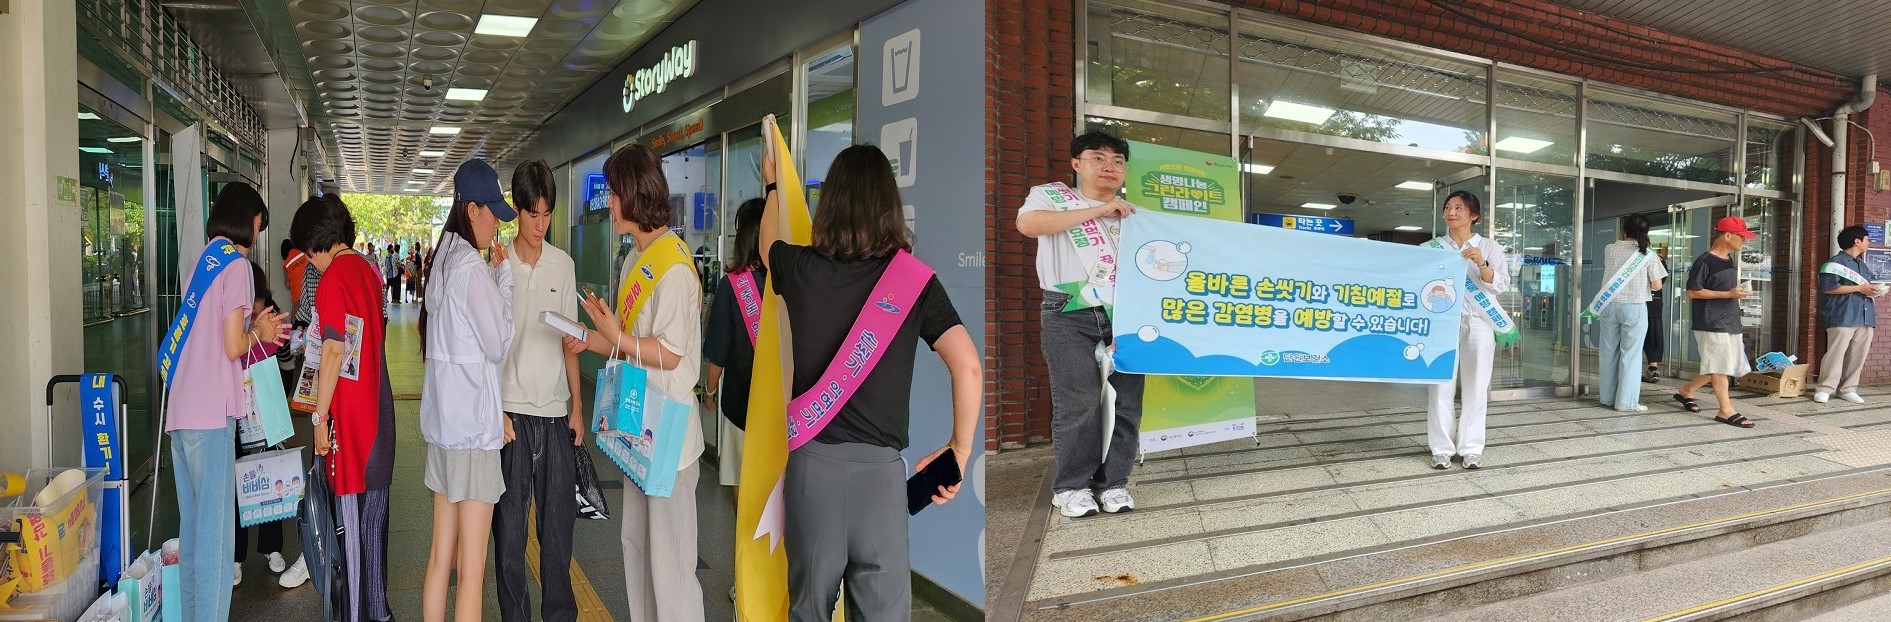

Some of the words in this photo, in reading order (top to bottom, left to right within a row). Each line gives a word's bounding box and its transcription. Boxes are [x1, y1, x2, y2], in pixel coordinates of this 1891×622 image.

[1159, 174, 1207, 189] 생명나눔
[1163, 197, 1208, 213] 캠페인
[1298, 217, 1314, 226] 타는
[1315, 218, 1323, 227] 곳
[1185, 270, 1250, 297] 올바른
[1255, 277, 1328, 302] 손씻기와
[1333, 284, 1417, 308] 기침예절로
[1161, 297, 1207, 323] 많은
[1213, 302, 1289, 327] 감염병을
[1294, 307, 1349, 330] 예방할
[1351, 314, 1367, 330] 수
[1369, 315, 1430, 336] 있습니다!
[844, 329, 878, 379] 손씻기
[1283, 352, 1330, 363] 단원보건소
[93, 396, 106, 426] 수시
[800, 380, 844, 428] 익혀먹기
[242, 475, 270, 494] 비비삼
